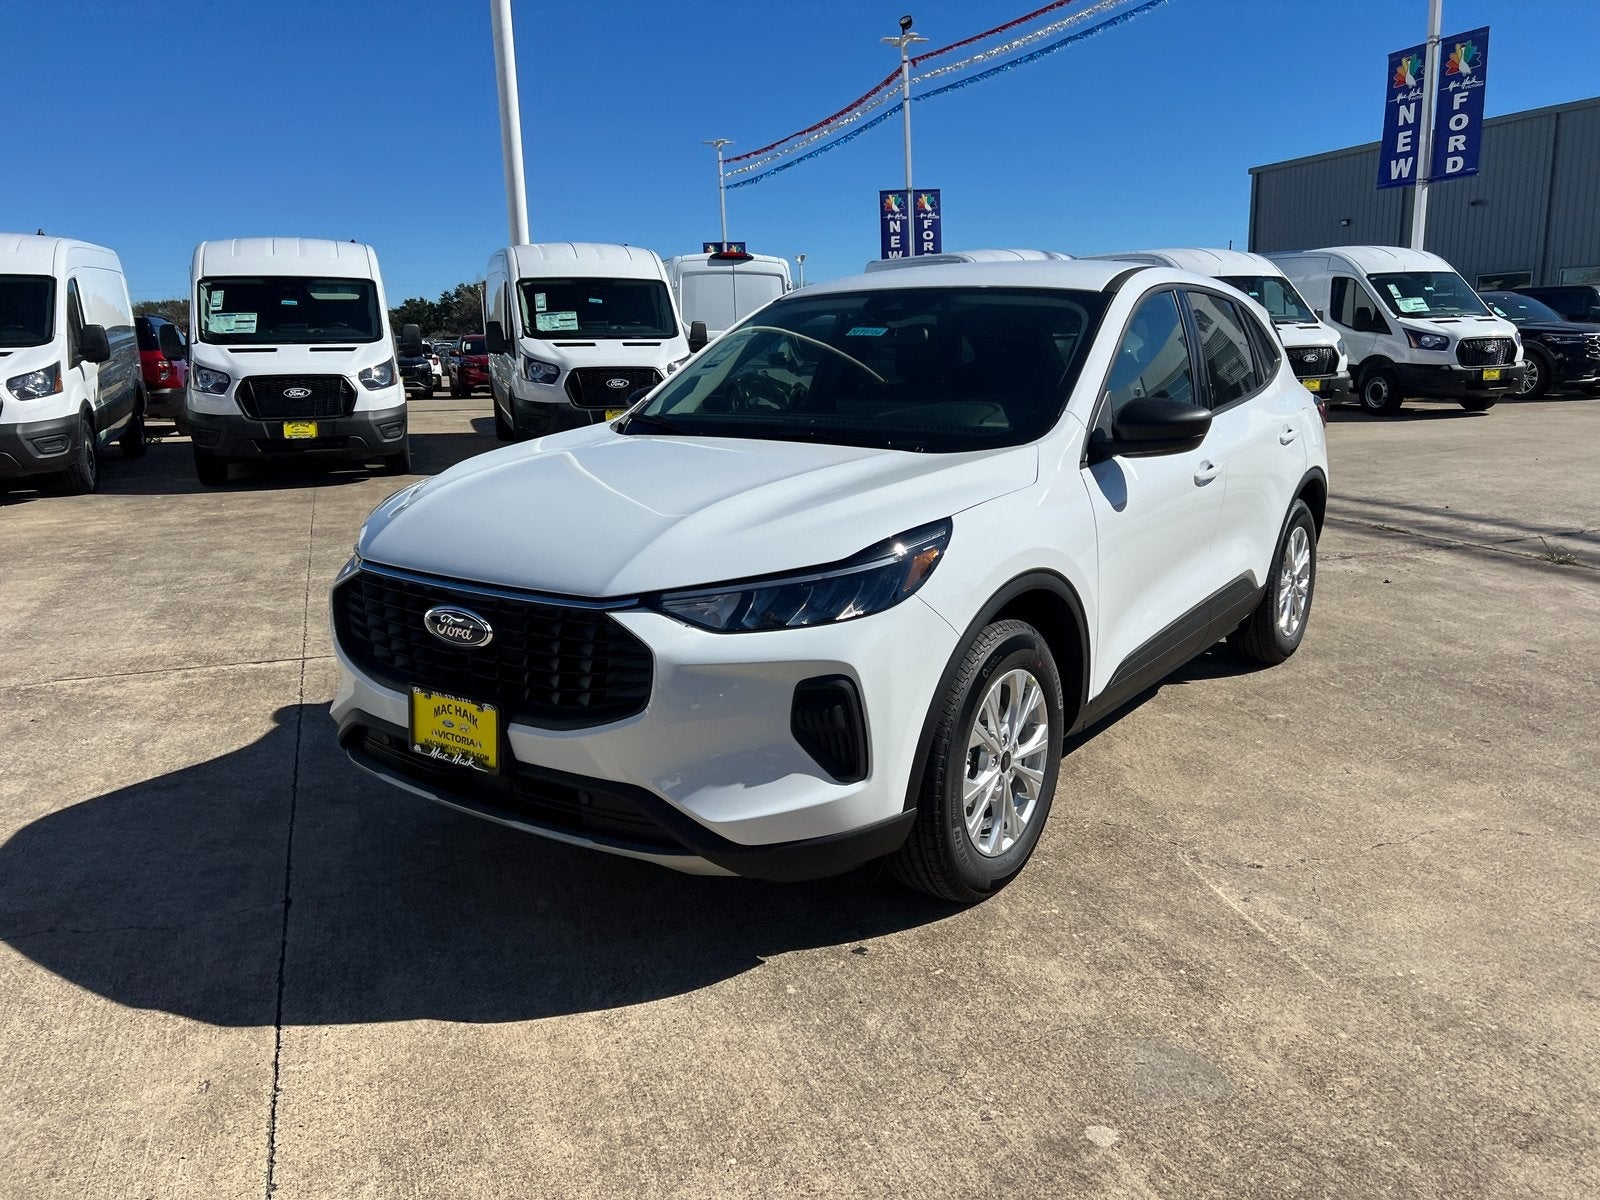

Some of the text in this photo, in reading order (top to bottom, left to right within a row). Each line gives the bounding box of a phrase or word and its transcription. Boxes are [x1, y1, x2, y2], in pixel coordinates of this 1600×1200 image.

[1390, 102, 1416, 180] NEW
[1445, 91, 1469, 174] FORD
[887, 220, 903, 259] NEW
[437, 614, 473, 640] Ford
[433, 703, 453, 718] MAC
[454, 705, 479, 730] HAIK
[437, 729, 476, 748] VICTORIA
[428, 746, 484, 771] Mac Haik
